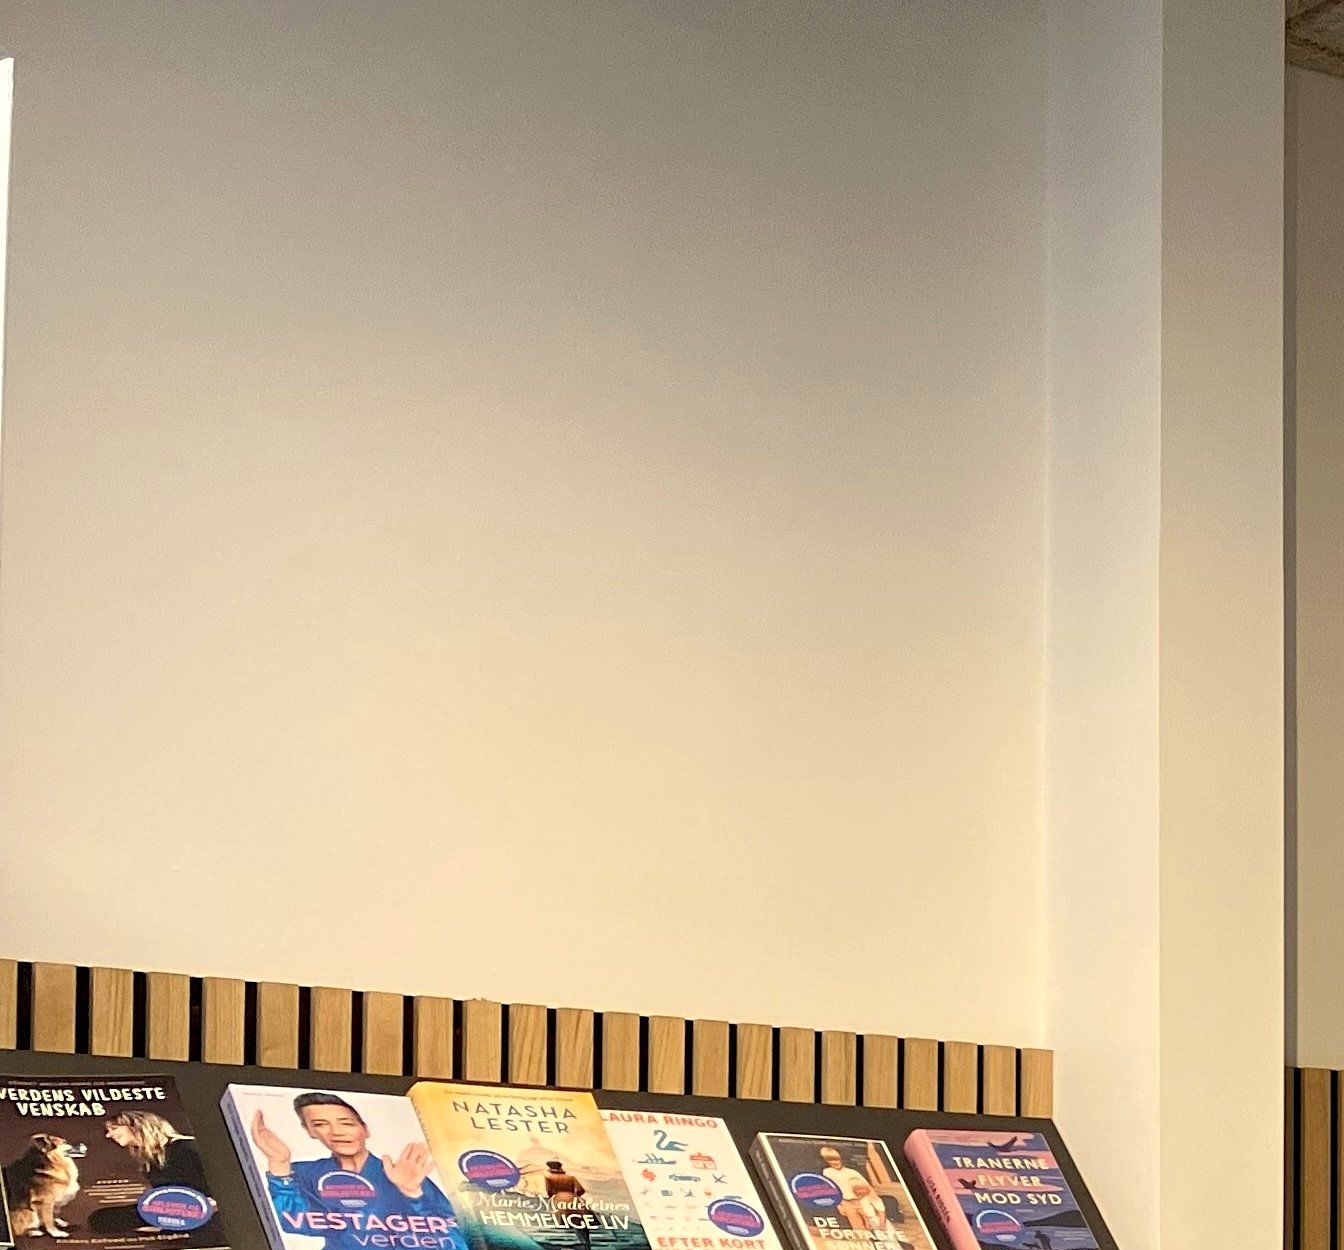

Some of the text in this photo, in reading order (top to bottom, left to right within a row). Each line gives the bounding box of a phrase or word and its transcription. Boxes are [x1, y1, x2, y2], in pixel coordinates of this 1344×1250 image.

[0, 1087, 166, 1102] VERDENS VILDESTE
[16, 1102, 106, 1116] VENSKAB
[452, 1100, 577, 1120] NATASHA
[471, 1117, 570, 1134] LESTER
[598, 1112, 718, 1129] LAURA RINGO
[952, 1156, 1050, 1170] TRANERNE
[977, 1175, 1043, 1188] FLYVER
[975, 1193, 1062, 1206] MOD SYD
[479, 1210, 630, 1230] HEMMELIGE LIV
[813, 1216, 840, 1229] DE
[352, 1233, 456, 1249] verden
[656, 1237, 766, 1250] EFTER KORT
